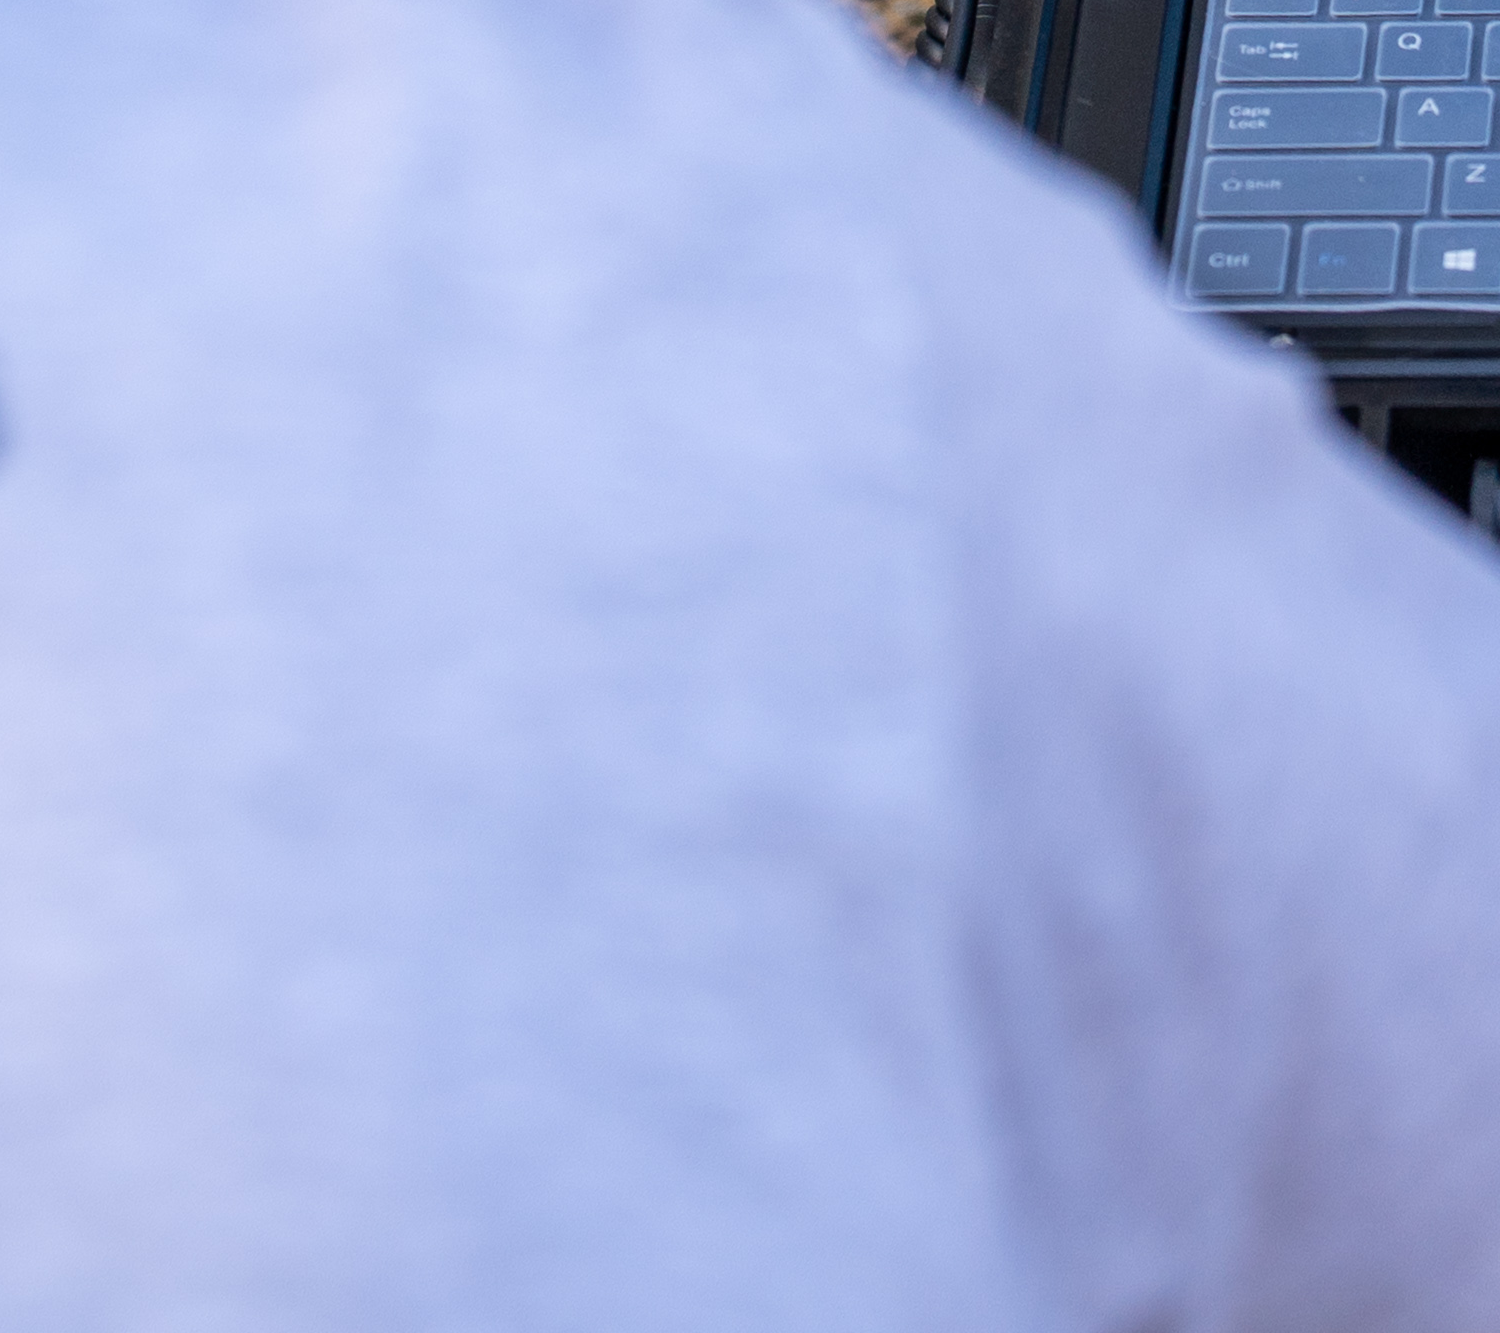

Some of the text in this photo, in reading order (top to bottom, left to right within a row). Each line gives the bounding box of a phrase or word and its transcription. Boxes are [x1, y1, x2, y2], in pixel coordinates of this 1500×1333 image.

[1398, 33, 1421, 50] Q
[1240, 44, 1266, 54] Tab
[1229, 106, 1271, 117] Caps
[1418, 98, 1439, 115] A
[1229, 119, 1266, 129] Lock
[1466, 164, 1486, 182] Z
[1245, 179, 1282, 190] Shift
[1209, 253, 1249, 267] Ctrl
